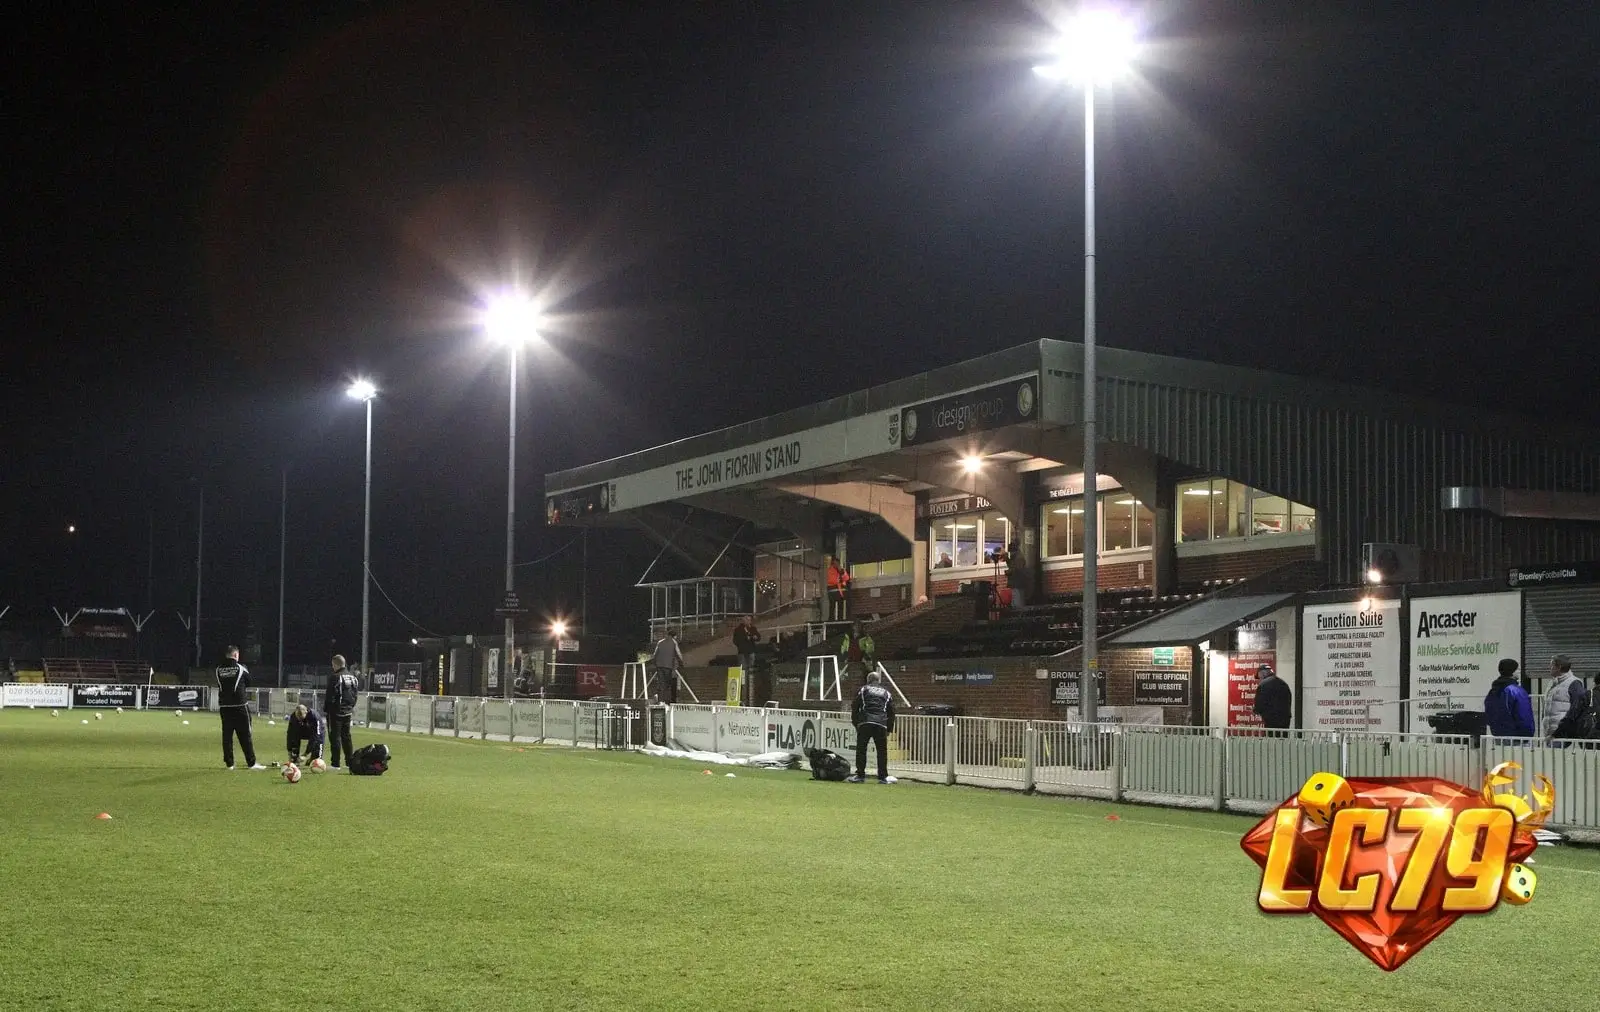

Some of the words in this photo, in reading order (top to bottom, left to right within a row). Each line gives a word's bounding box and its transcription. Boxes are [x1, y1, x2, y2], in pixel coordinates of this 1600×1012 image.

[676, 468, 693, 490] THE
[697, 460, 721, 486] JOHN
[726, 451, 761, 480] FIORINI
[765, 441, 801, 471] STAND
[1518, 569, 1577, 581] BromleyFootballClub
[1317, 613, 1357, 629] Function
[1360, 611, 1383, 627] Suite
[1417, 609, 1477, 638] Ancaster
[1417, 645, 1426, 656] All
[1427, 644, 1449, 656] Makes
[1450, 644, 1474, 655] Service
[1475, 643, 1482, 654] &
[1483, 642, 1499, 655] MOT
[1454, 663, 1467, 671] Service
[1051, 671, 1083, 679] BROML
[1163, 673, 1188, 681] OFFICIAL
[1158, 683, 1182, 691] WEBSITE
[728, 721, 759, 737] Networkers
[768, 723, 795, 750] FILA
[805, 727, 815, 748] JD
